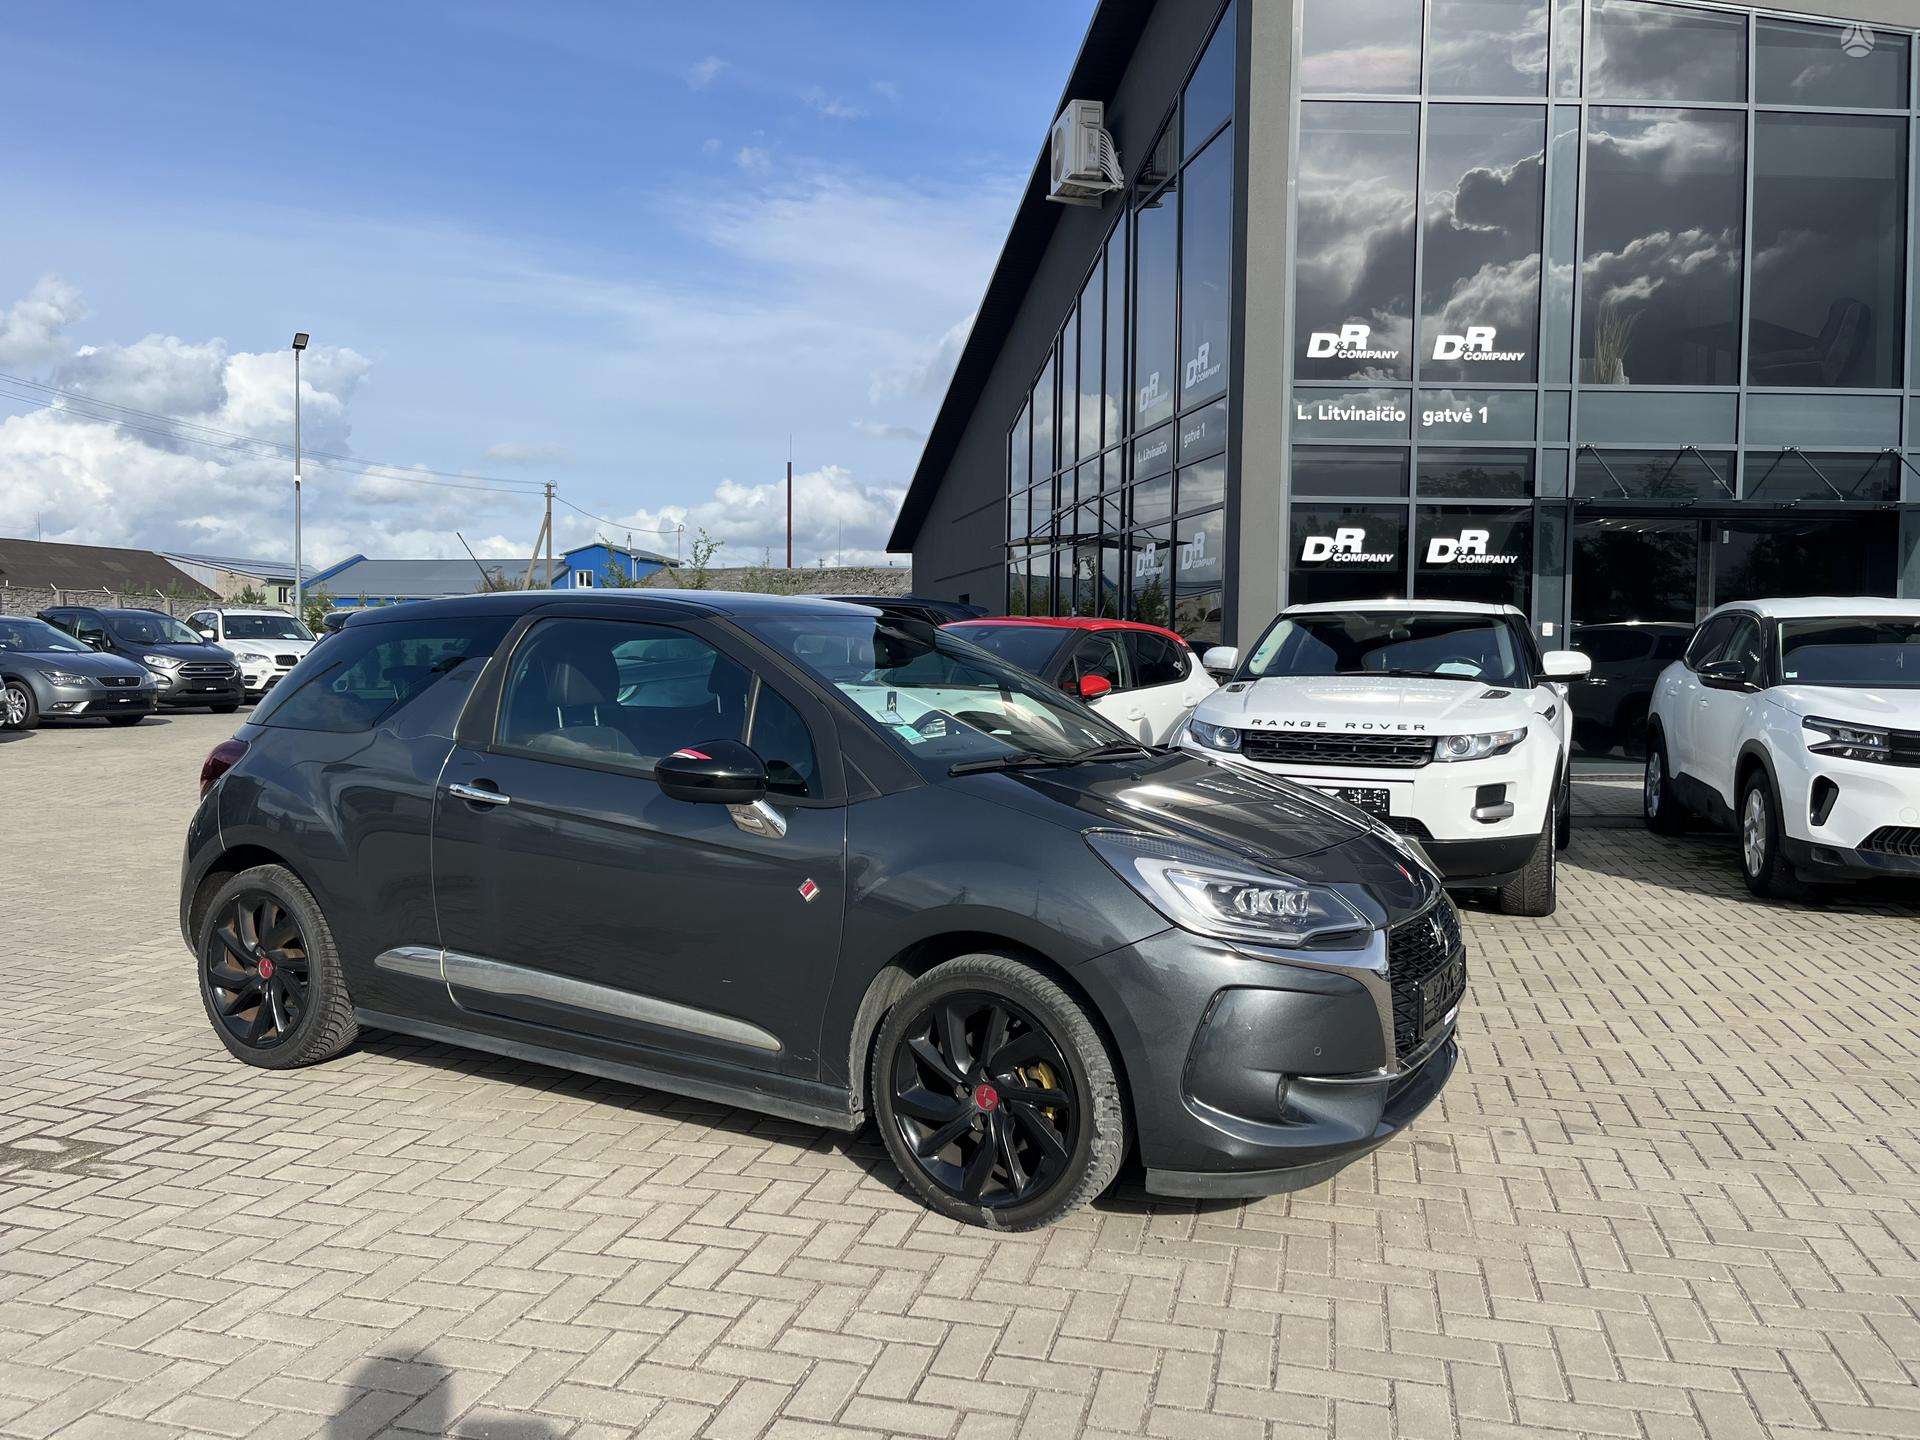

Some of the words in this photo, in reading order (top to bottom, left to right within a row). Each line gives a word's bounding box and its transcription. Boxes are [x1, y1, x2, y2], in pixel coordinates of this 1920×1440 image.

[1338, 350, 1399, 360] COMPANY
[1463, 352, 1526, 361] COMPANY
[1139, 371, 1160, 413] DR
[1297, 405, 1312, 420] L.
[1318, 405, 1406, 422] Litvinaičio
[1422, 408, 1473, 427] gatvė
[1478, 407, 1488, 424] 1
[1201, 422, 1206, 438] 1
[1136, 542, 1156, 577] DR
[1332, 553, 1394, 563] COMPANY
[1457, 554, 1518, 564] COMPANY
[1251, 719, 1328, 728] RANGE
[1345, 722, 1426, 731] ROVER
